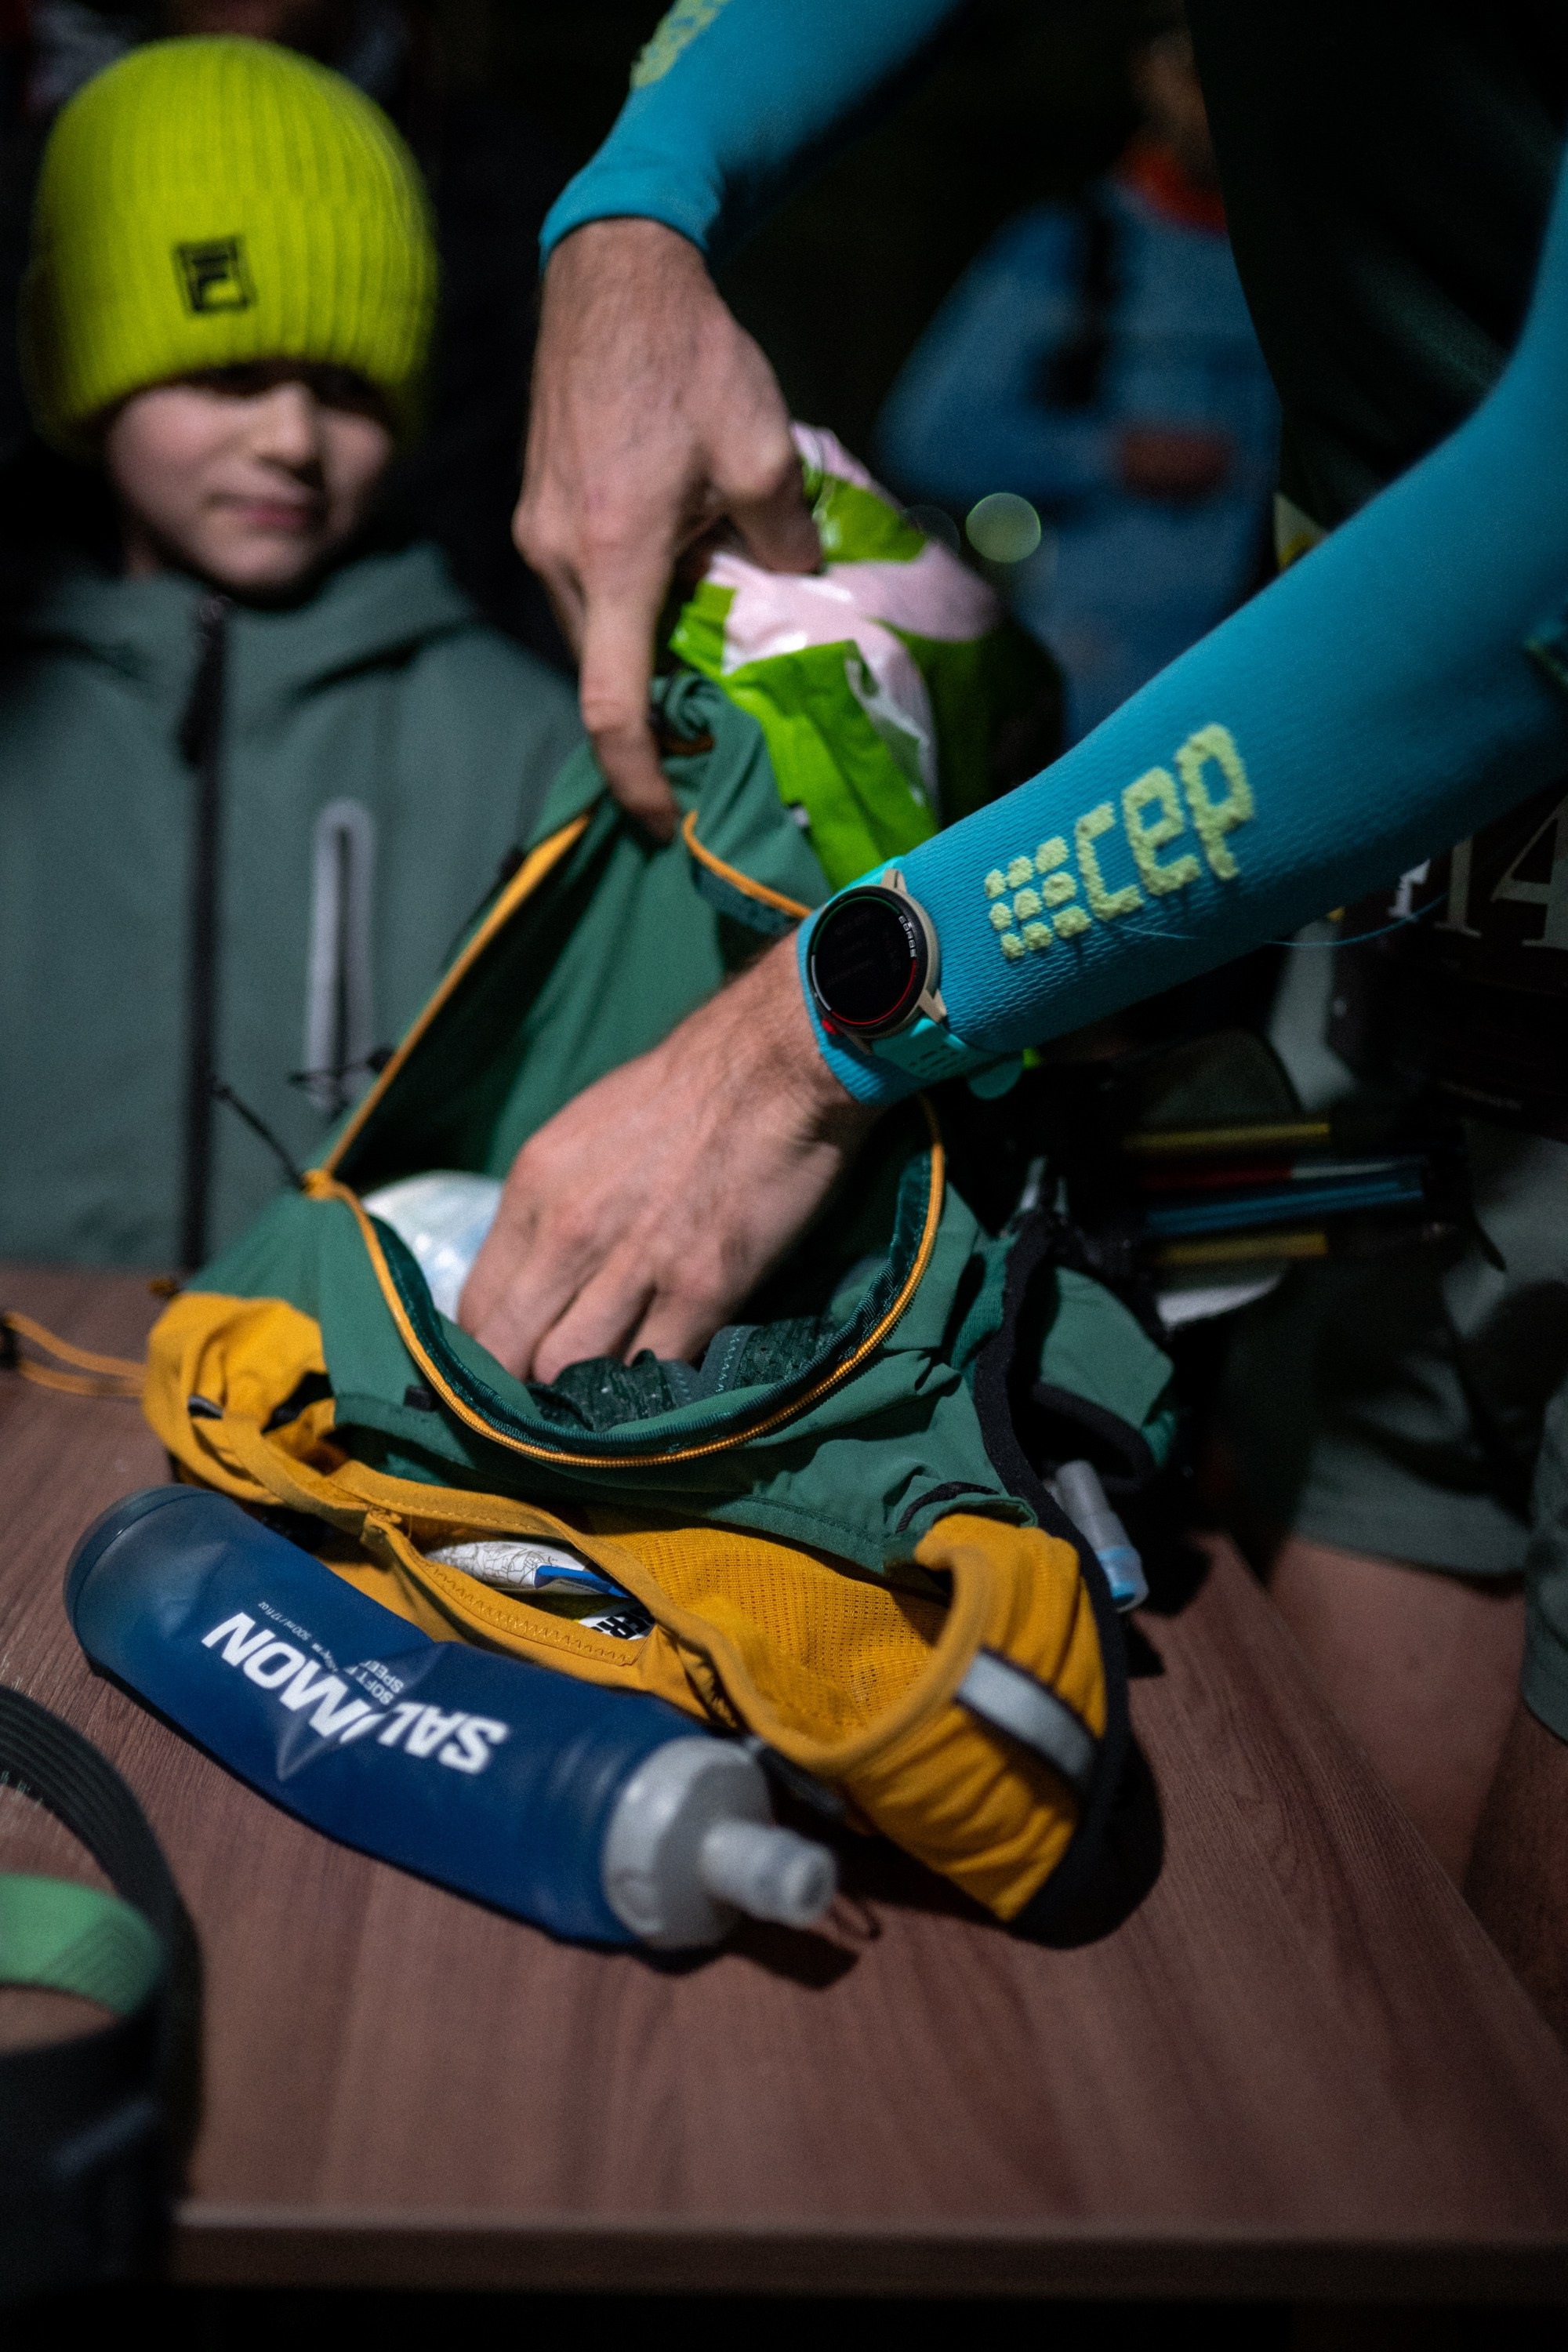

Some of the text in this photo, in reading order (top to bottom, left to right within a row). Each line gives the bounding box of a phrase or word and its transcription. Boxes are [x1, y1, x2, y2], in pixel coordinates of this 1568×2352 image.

[1074, 722, 1255, 921] cep
[201, 1611, 511, 1776] SALMON
[355, 1671, 394, 1706] SOFT
